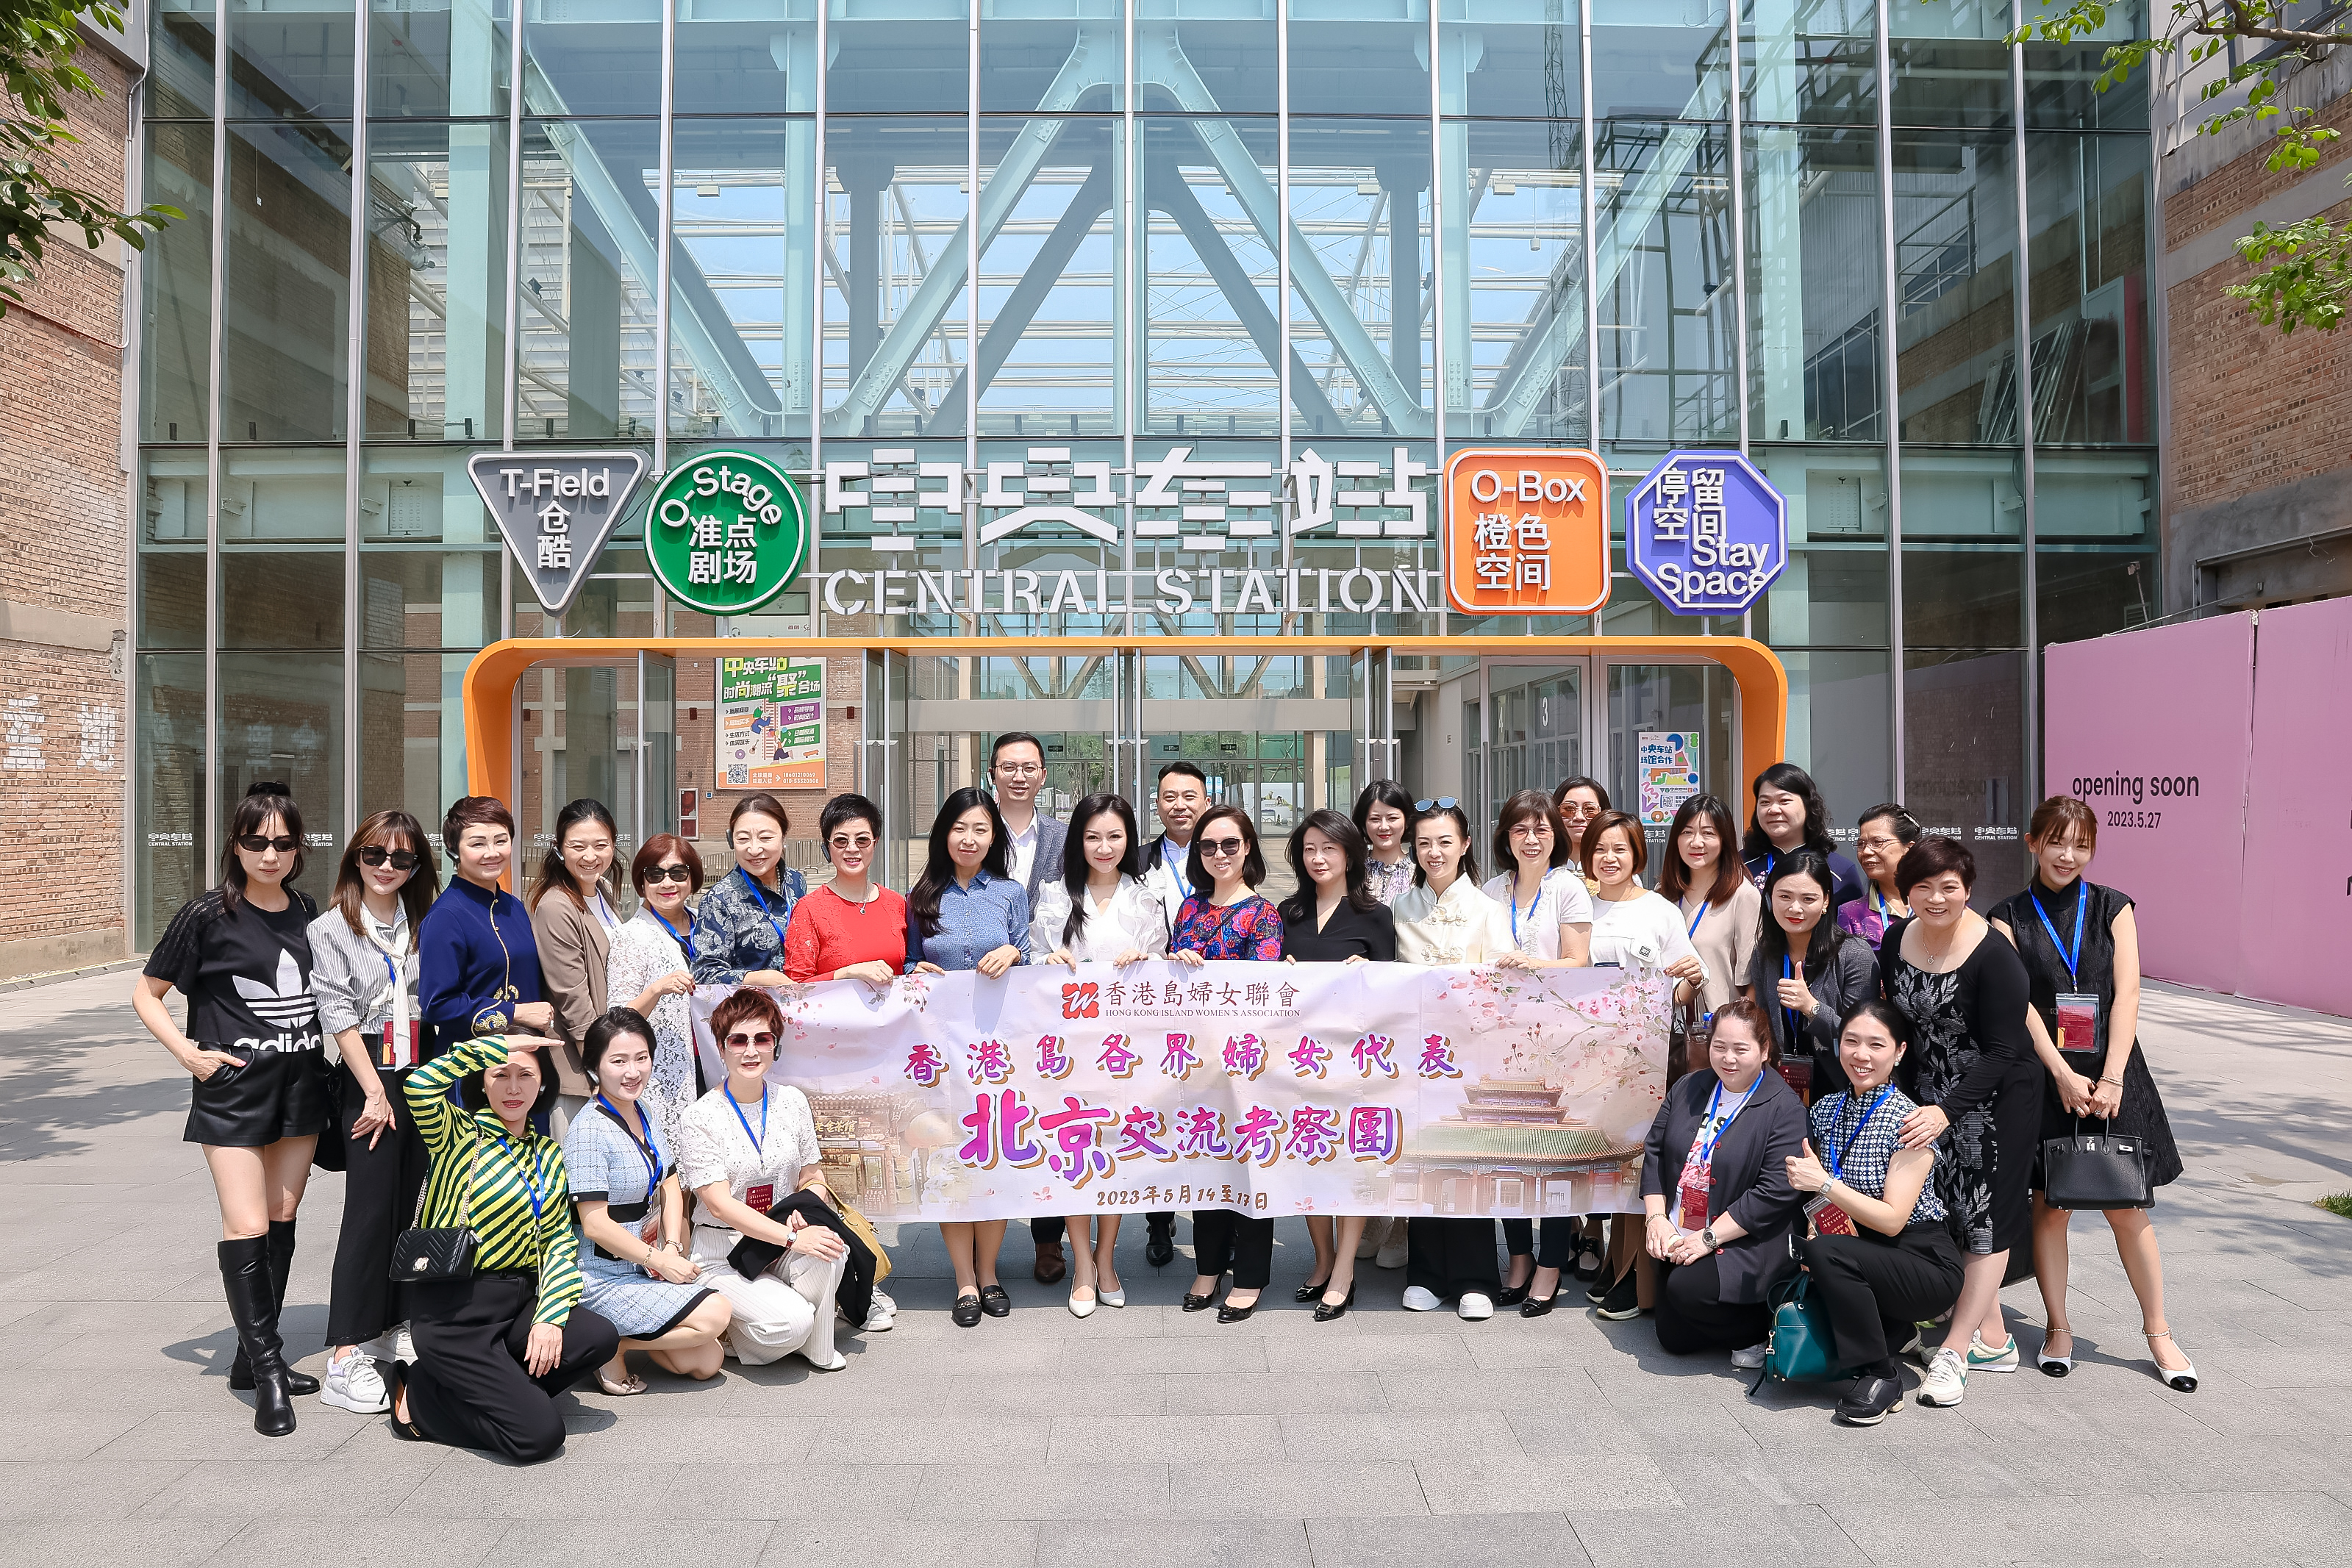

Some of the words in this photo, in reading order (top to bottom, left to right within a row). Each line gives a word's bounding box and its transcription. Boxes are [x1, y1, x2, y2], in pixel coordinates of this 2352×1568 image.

[499, 468, 610, 498] T-Field
[660, 465, 782, 528] O-Stage
[1471, 469, 1587, 504] O-Box
[1655, 468, 1725, 505] 停留
[688, 515, 759, 549] 准点
[1473, 513, 1551, 551] 橙色
[1653, 504, 1726, 541] 空间
[687, 551, 758, 585] 剧场
[1475, 552, 1551, 591] 空间
[1691, 534, 1769, 573] Stay
[825, 568, 1128, 615] CENTRAL
[1155, 568, 1428, 615] STATION
[1656, 562, 1767, 603] Space
[1542, 696, 1548, 727] 3
[1640, 744, 1673, 753] 中央车站
[1640, 755, 1673, 765] 场馆合作
[2072, 770, 2144, 805] opening
[2150, 774, 2200, 798] soon
[2107, 811, 2162, 828] 2023.5.27
[1104, 981, 1301, 1007] 香港島婦女聯會
[903, 1032, 1462, 1085] 香港島各界婦女代表
[958, 1092, 1404, 1186] 北京交流考察團
